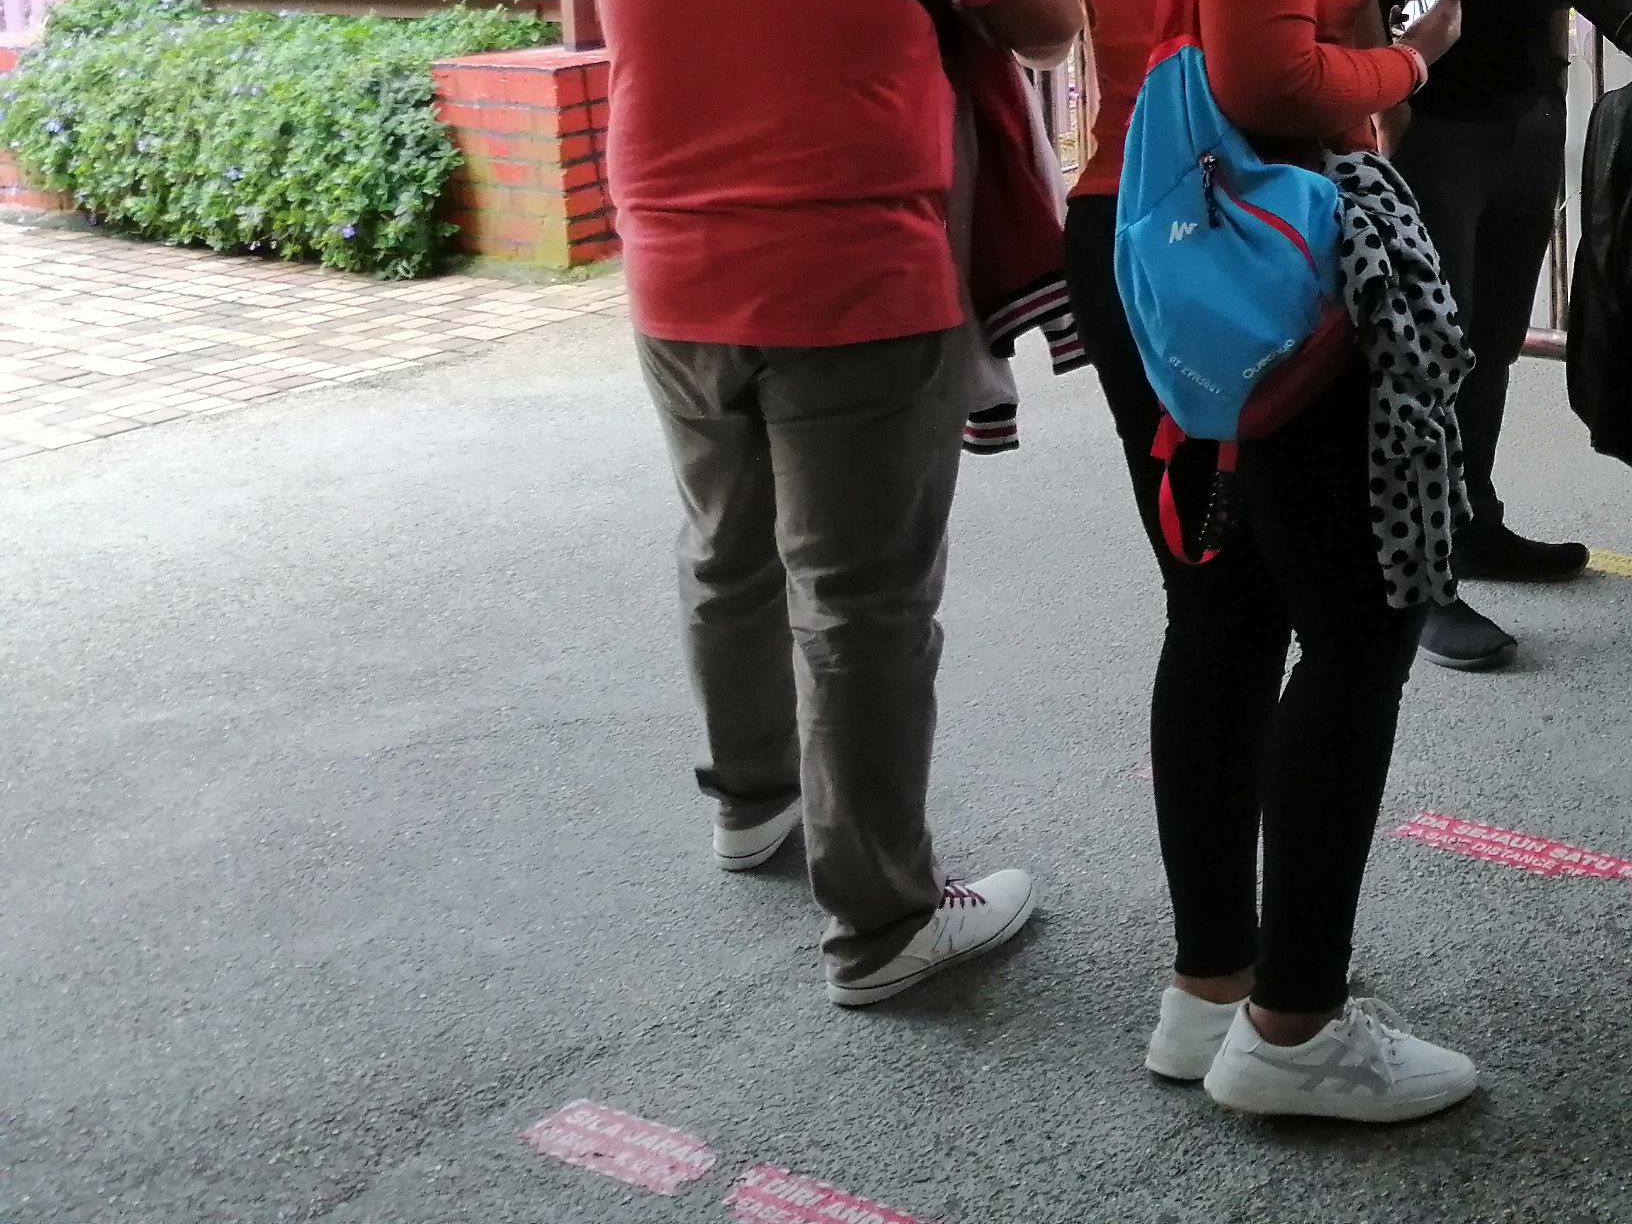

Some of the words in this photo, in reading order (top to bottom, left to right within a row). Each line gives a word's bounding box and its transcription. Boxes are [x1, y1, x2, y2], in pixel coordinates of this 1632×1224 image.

[1471, 841, 1559, 870] DISTANCE
[1549, 848, 1616, 871] SATU
[564, 1109, 626, 1137] SILA
[761, 1177, 829, 1207] DIRI
